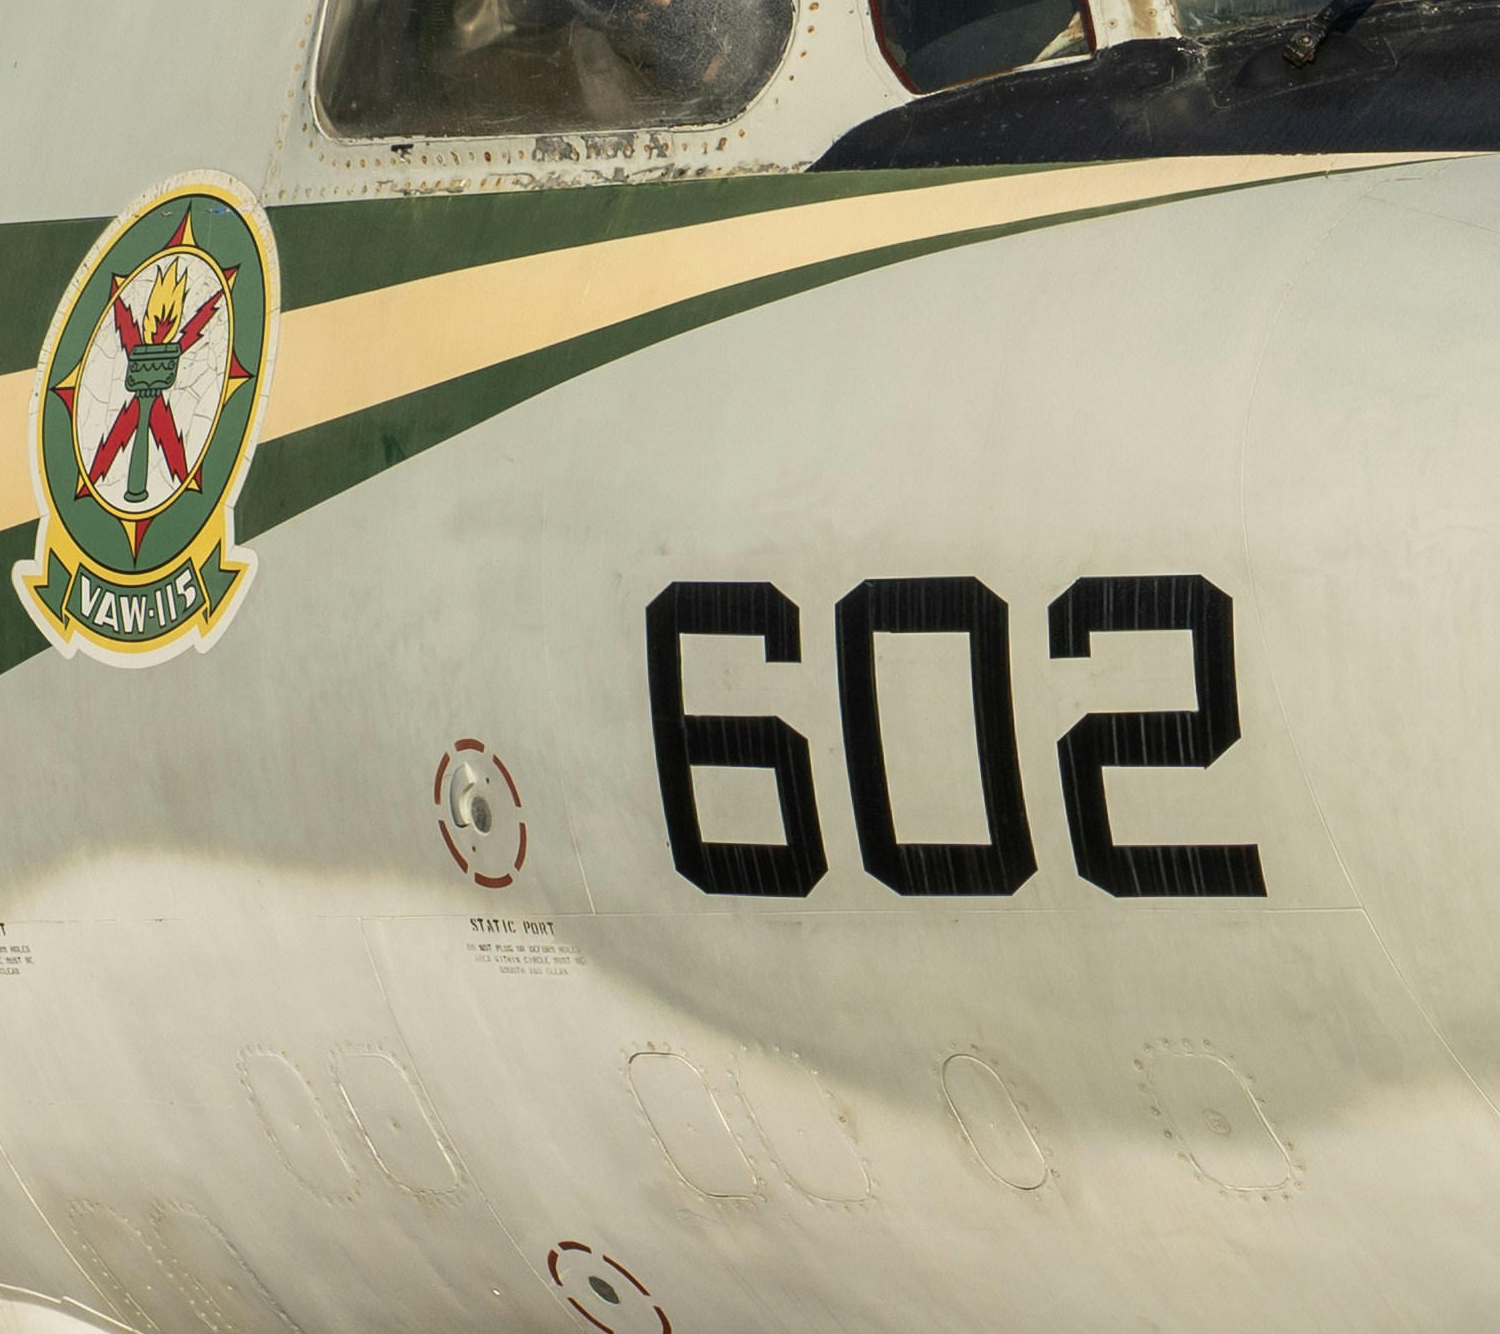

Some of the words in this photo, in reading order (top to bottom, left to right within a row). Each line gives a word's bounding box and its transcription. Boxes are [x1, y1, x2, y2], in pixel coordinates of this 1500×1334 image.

[79, 568, 198, 634] VAW-115
[645, 574, 1268, 898] 602
[470, 918, 516, 934] STATIC
[523, 921, 555, 936] PORT
